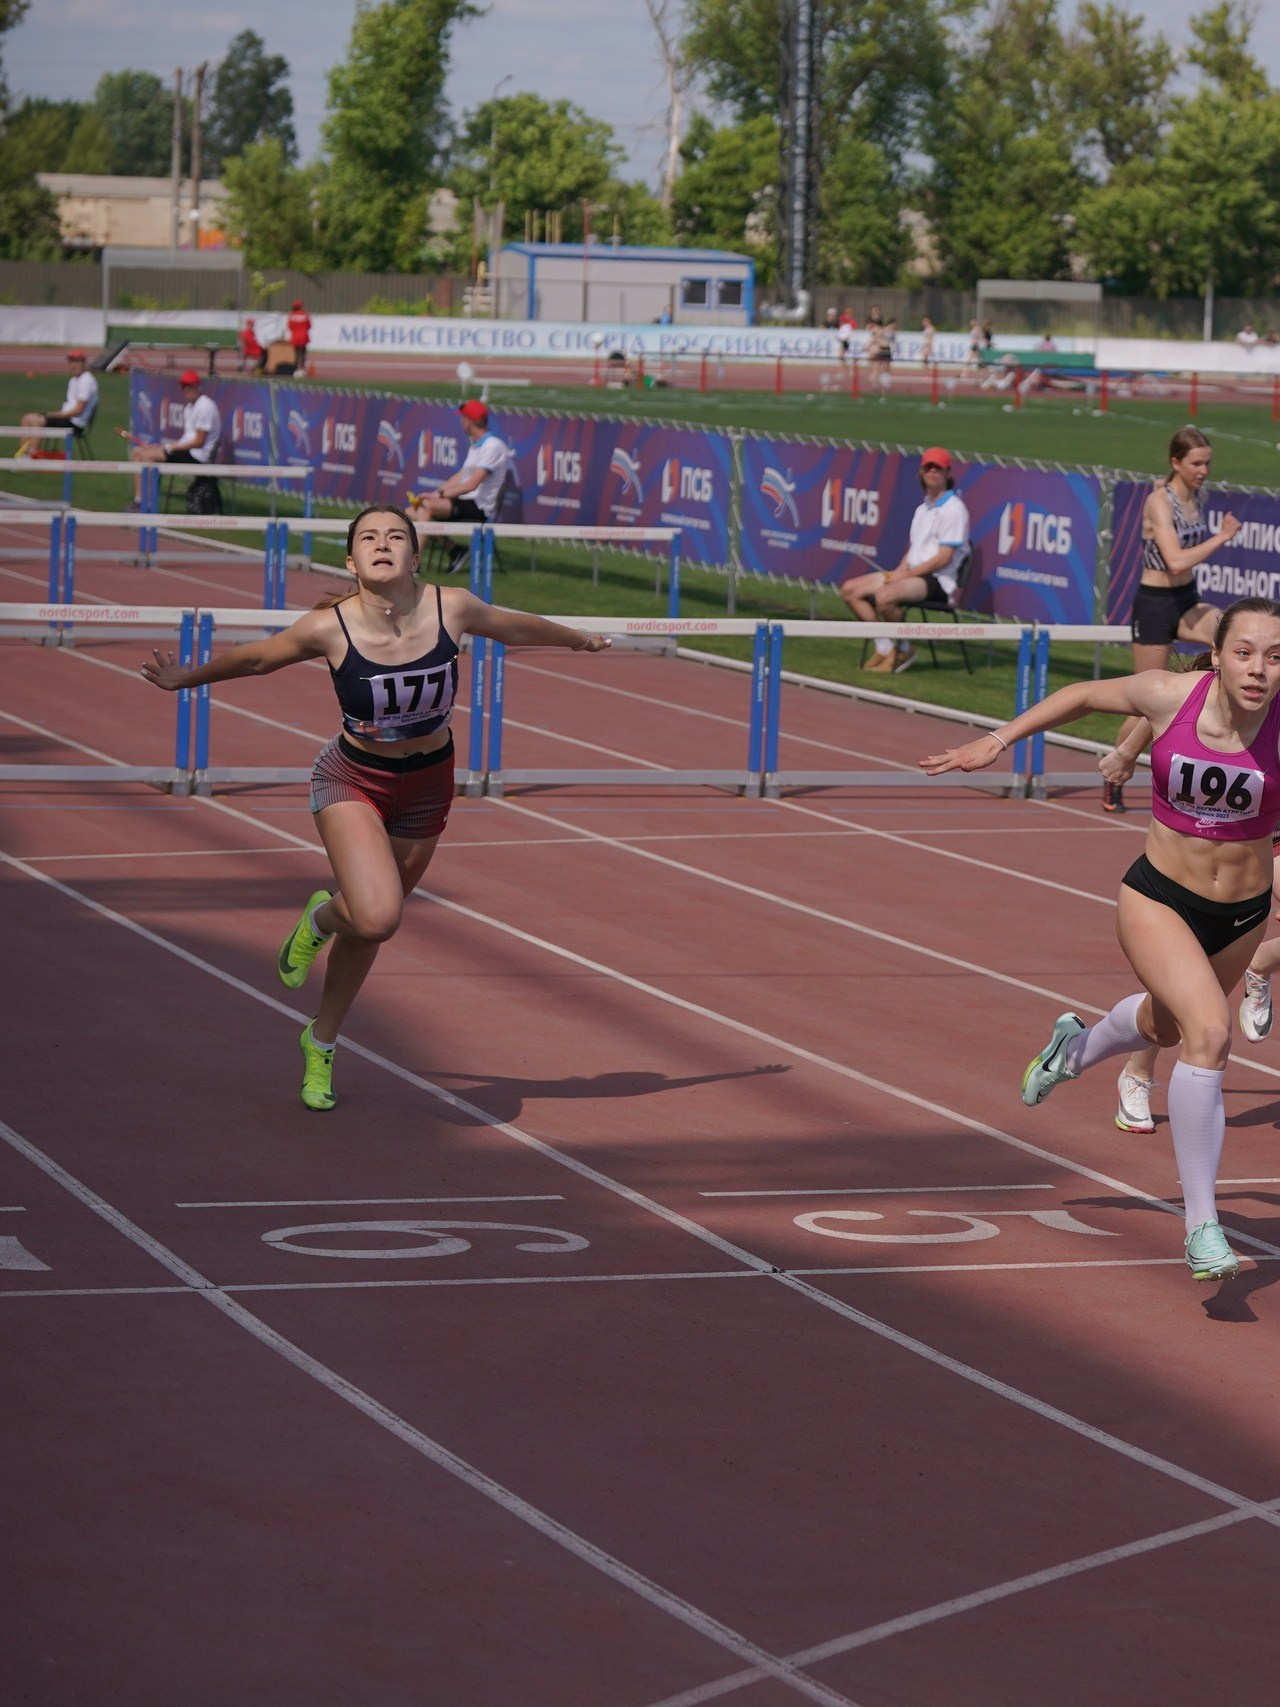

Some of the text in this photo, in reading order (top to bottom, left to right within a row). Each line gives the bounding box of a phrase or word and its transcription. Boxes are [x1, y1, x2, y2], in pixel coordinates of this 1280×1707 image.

[339, 324, 535, 349] МИНИСТЕРСТВО
[334, 421, 356, 451] ПСБ
[432, 435, 457, 467] ПСБ
[554, 450, 581, 483] ПСБ
[680, 465, 713, 502] ПСБ
[843, 487, 880, 527] ПСБ
[1026, 512, 1072, 556] ПСБ
[39, 607, 140, 621] nordicsport.com
[626, 621, 718, 633] nordicsport.com
[896, 626, 985, 638] nordicsport.com
[383, 669, 447, 715] 177
[1175, 762, 1252, 811] 196
